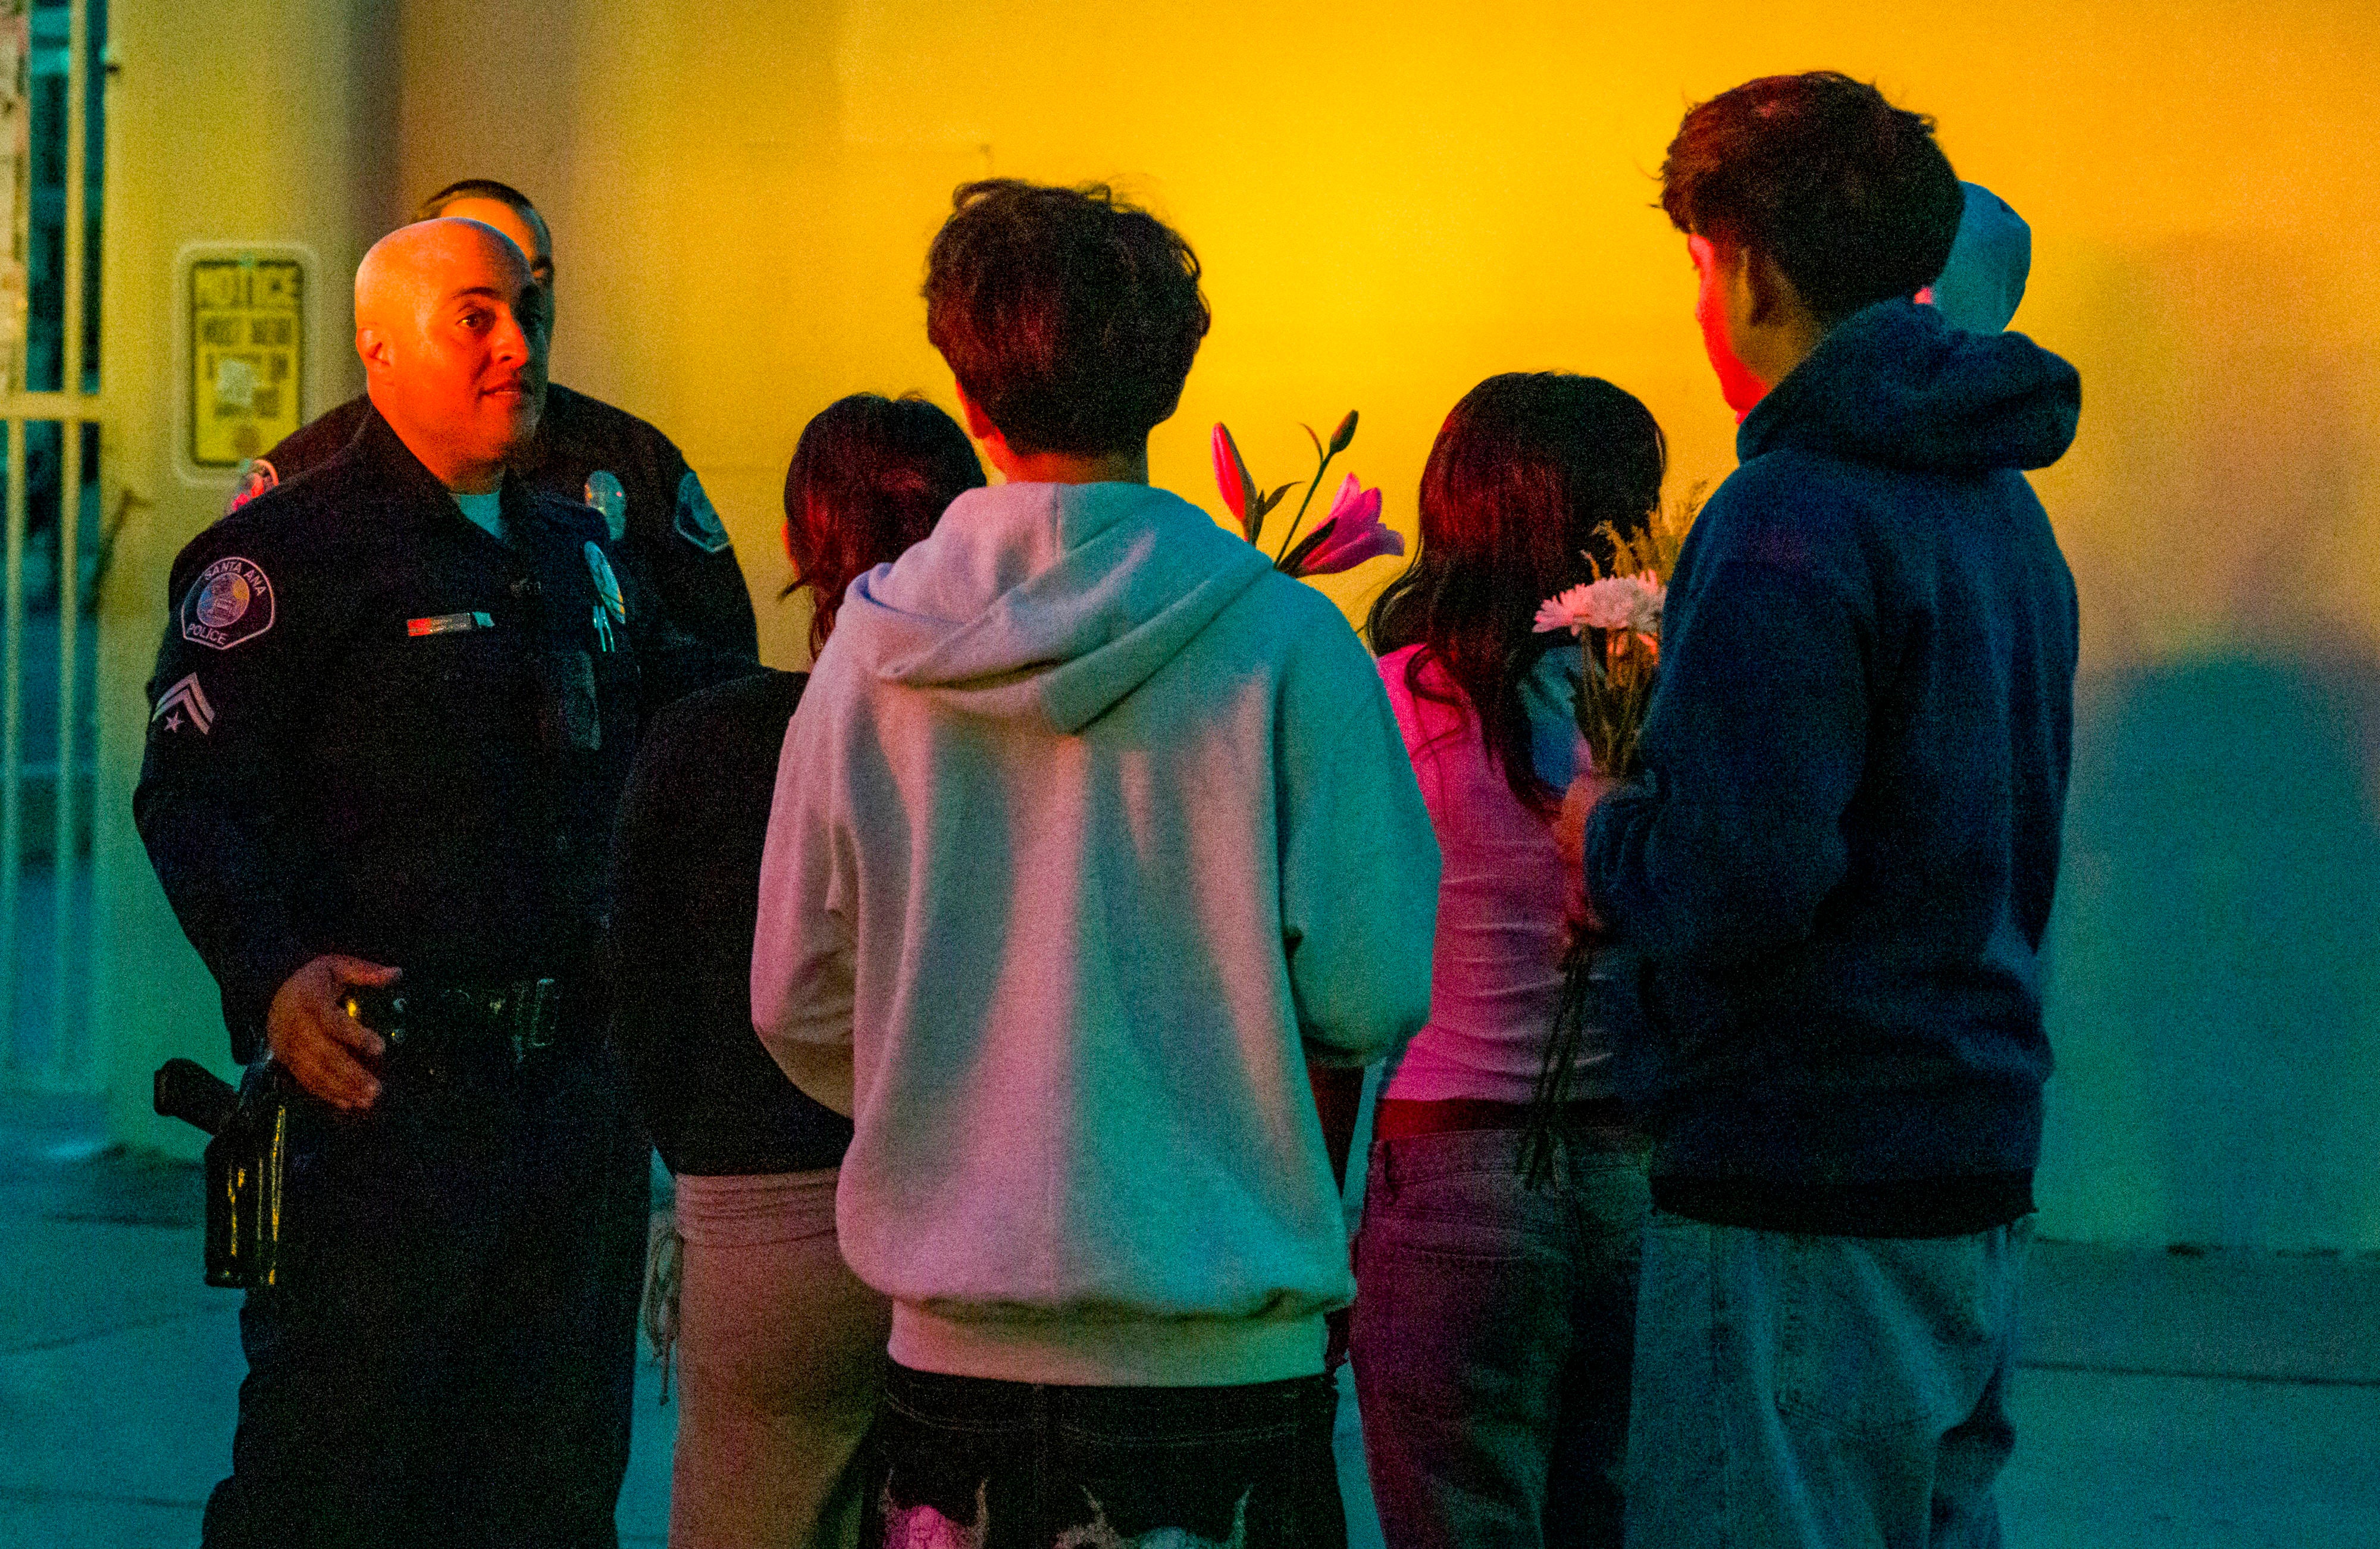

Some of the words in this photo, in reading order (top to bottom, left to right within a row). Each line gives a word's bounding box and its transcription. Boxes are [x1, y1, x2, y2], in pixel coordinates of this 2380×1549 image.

[204, 561, 242, 581] SANTA
[243, 569, 267, 596] ANA
[186, 623, 228, 645] POLICE
